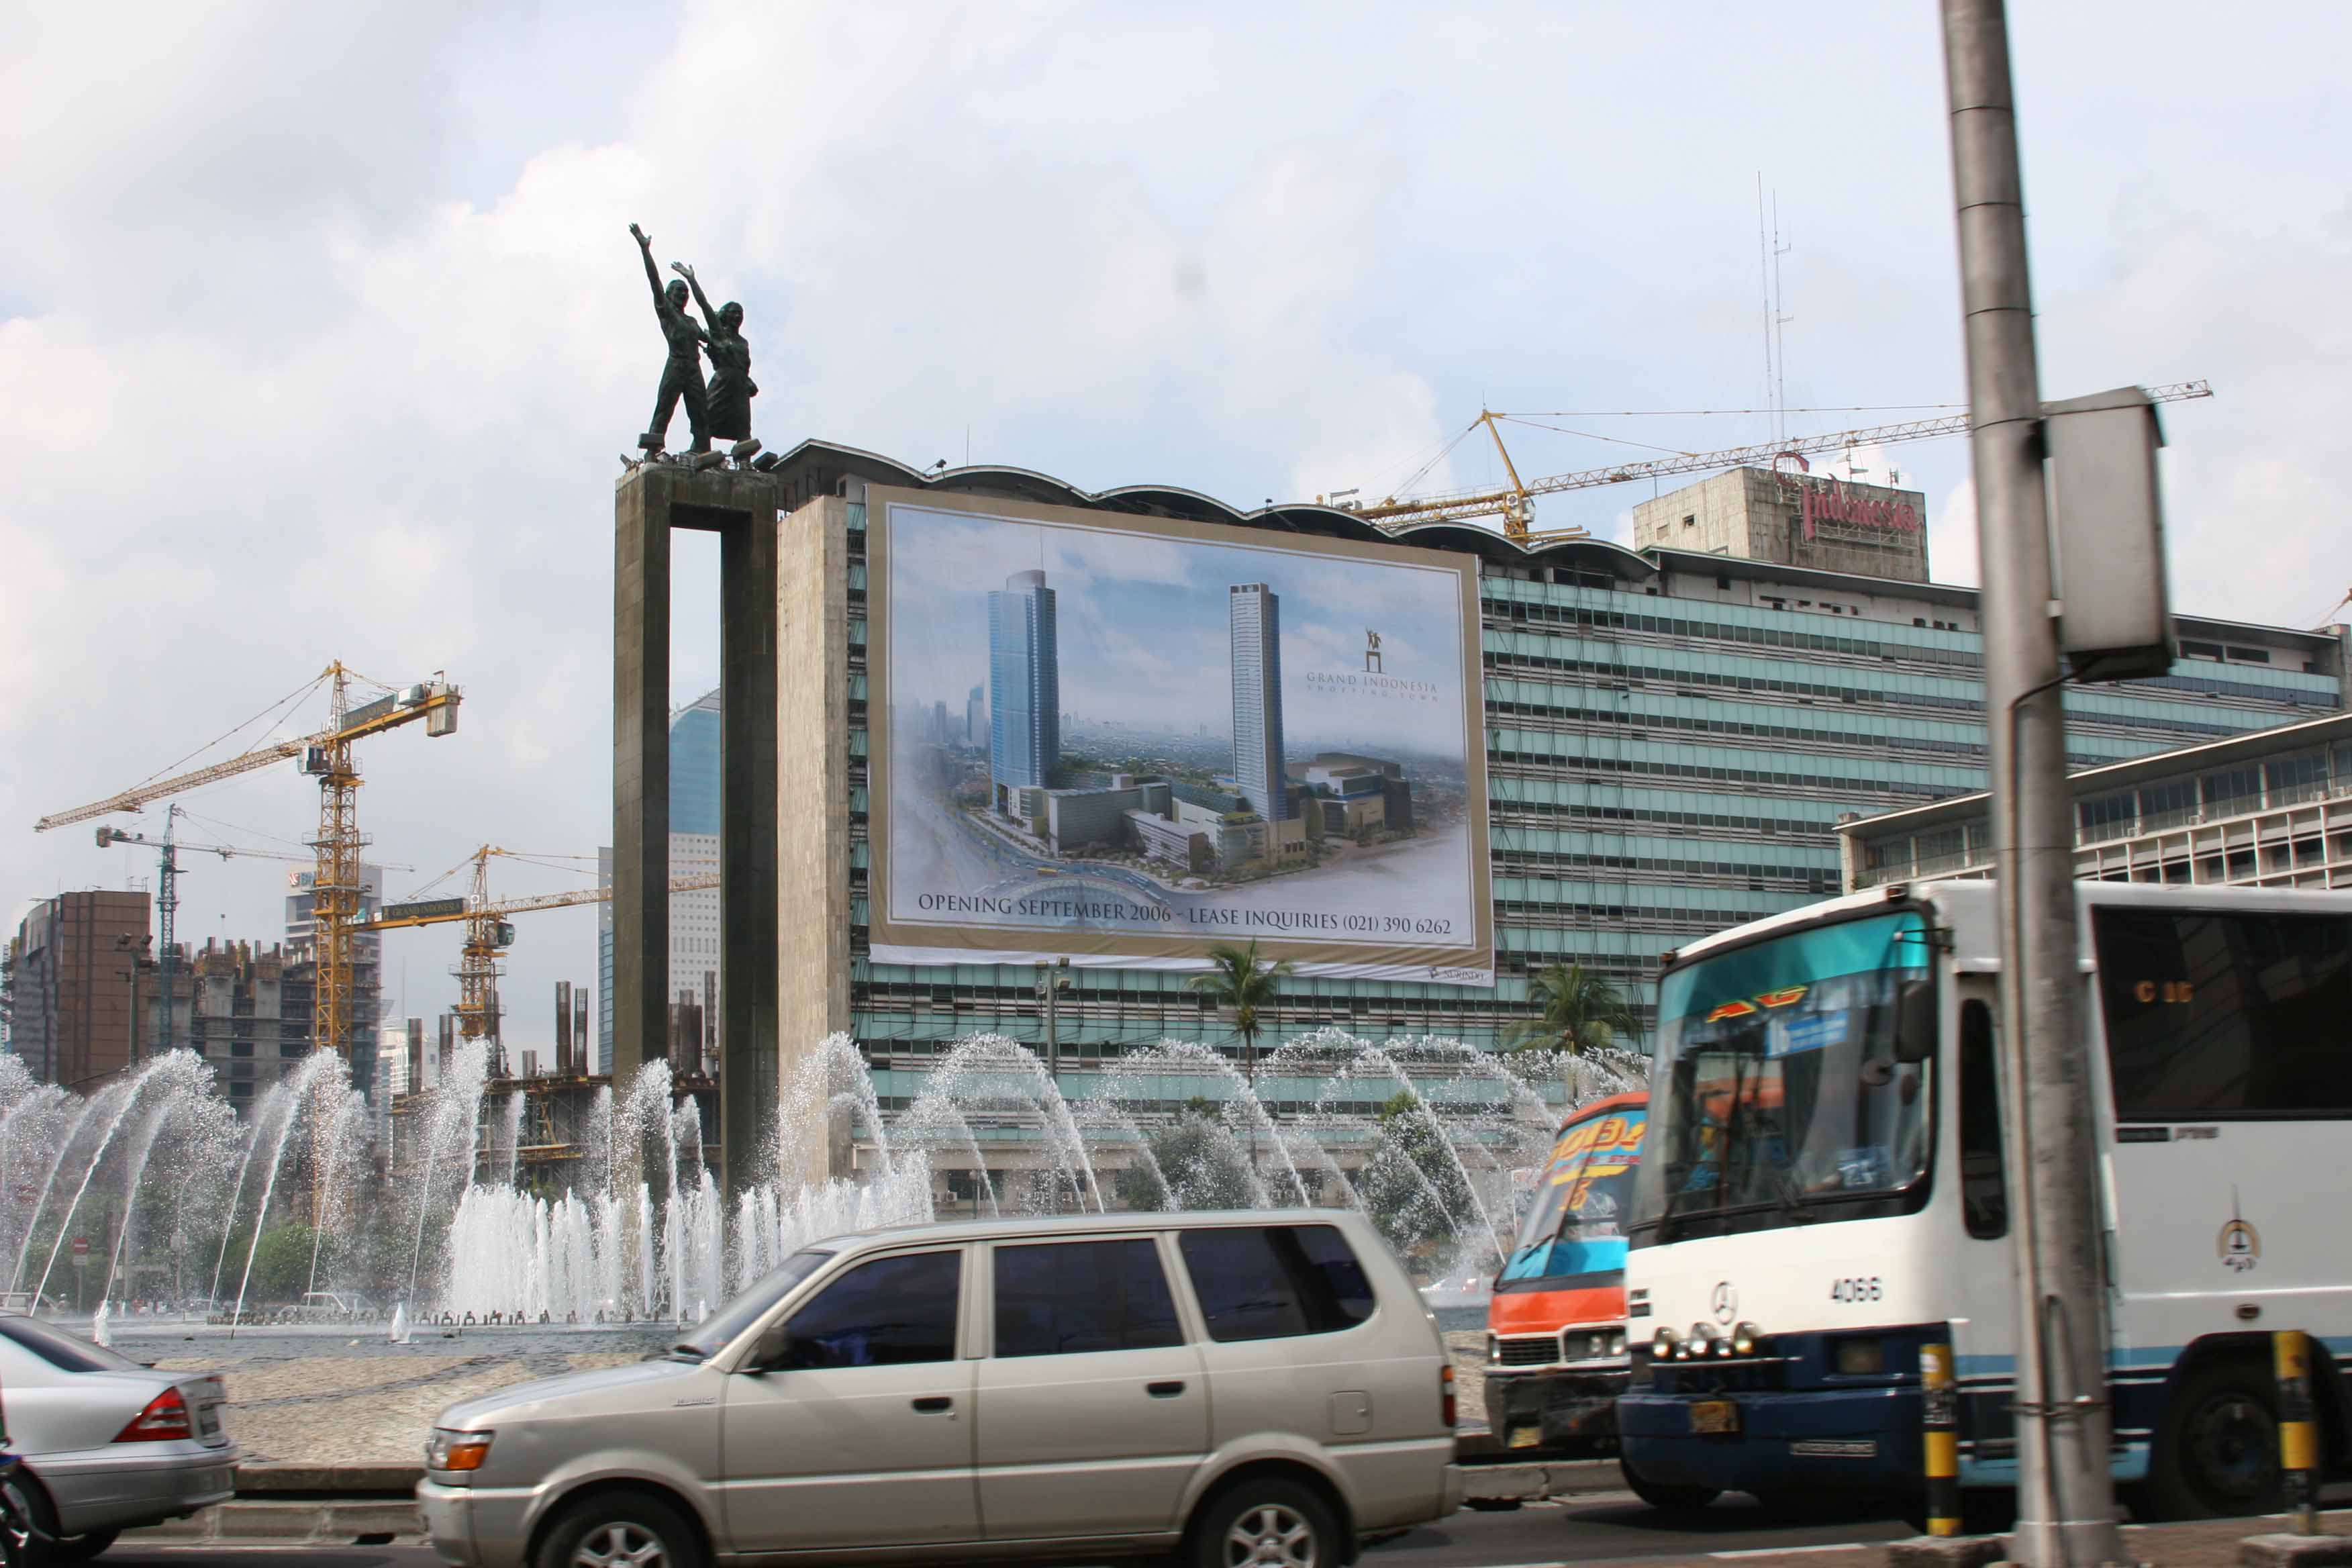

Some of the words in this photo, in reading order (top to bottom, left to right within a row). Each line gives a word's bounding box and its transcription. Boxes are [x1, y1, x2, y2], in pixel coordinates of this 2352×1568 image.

[1306, 671, 1357, 685] GRAND
[1364, 676, 1438, 693] INDONESIA
[918, 893, 1012, 915] OPENING
[1018, 899, 1126, 920] SEPTEMBER
[1130, 905, 1171, 923] 2006
[1189, 908, 1239, 925] LEASE
[1245, 910, 1338, 930] INQUIRIES
[1342, 915, 1379, 932] (021)
[1383, 916, 1410, 934] 390
[1416, 918, 1451, 935] 6262
[1830, 1277, 1883, 1303] 4066
